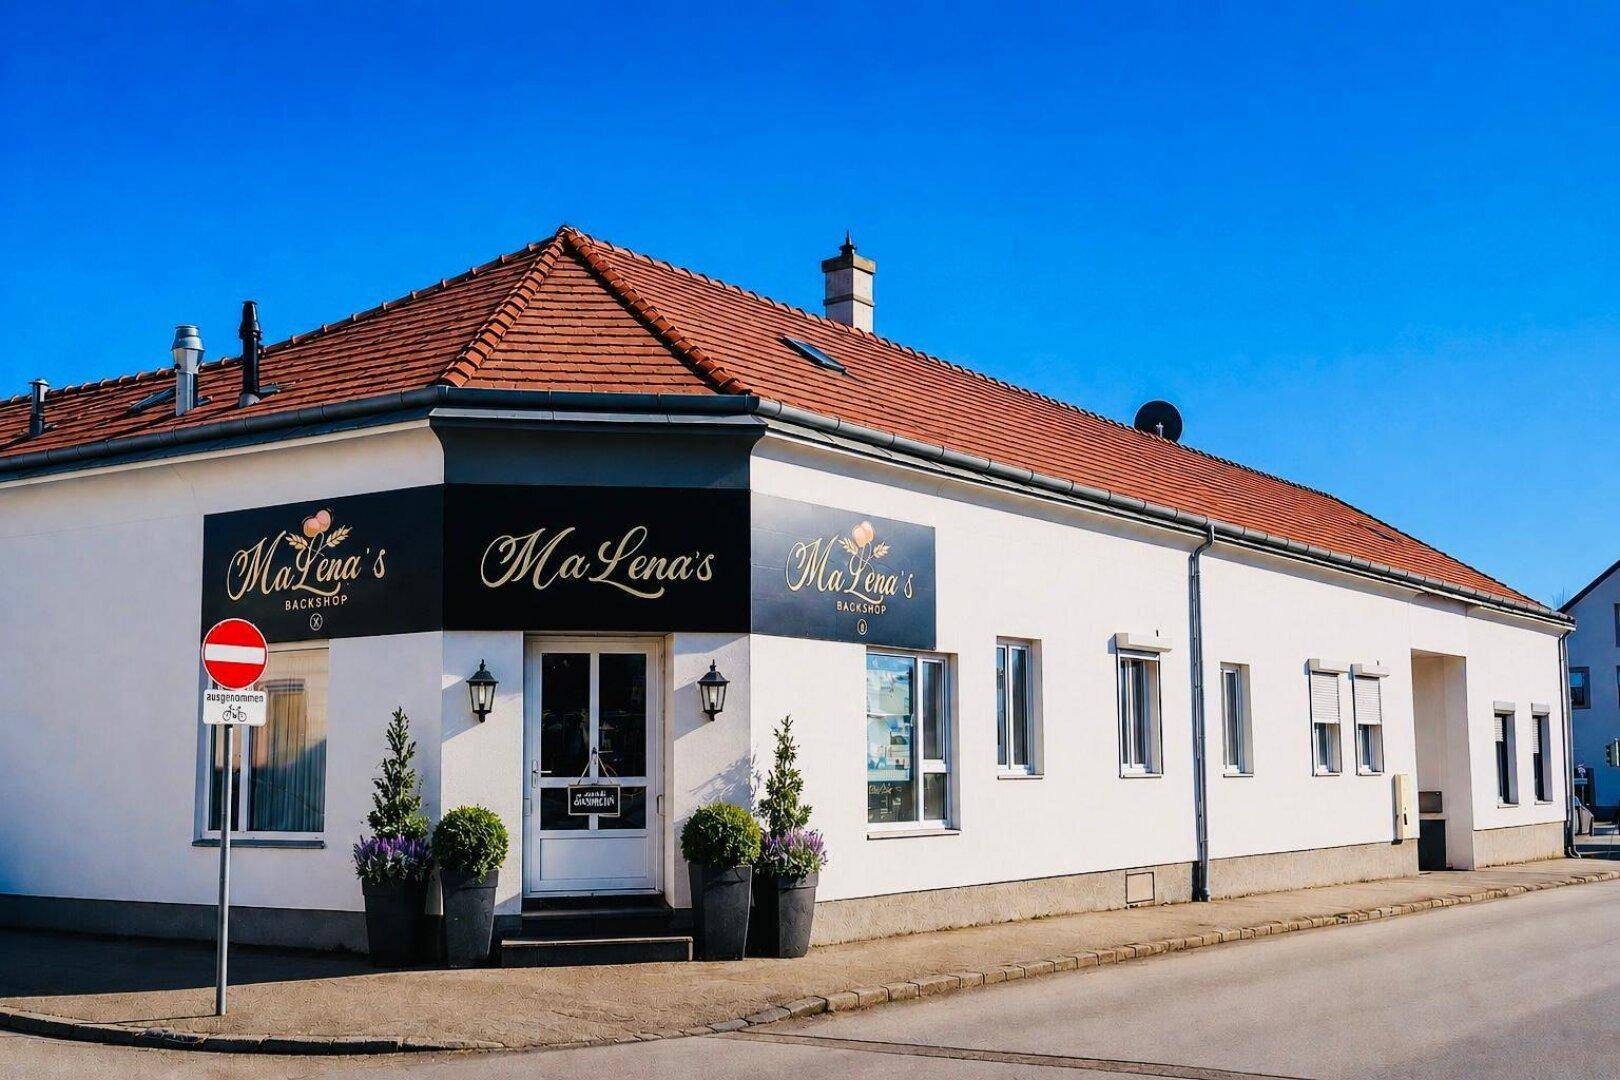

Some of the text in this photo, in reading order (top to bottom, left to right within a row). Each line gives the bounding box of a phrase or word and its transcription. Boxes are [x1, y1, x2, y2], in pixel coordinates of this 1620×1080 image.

[285, 595, 348, 611] BACKSHOP
[837, 601, 887, 614] BACKSHOP
[207, 693, 264, 704] ausgenommen
